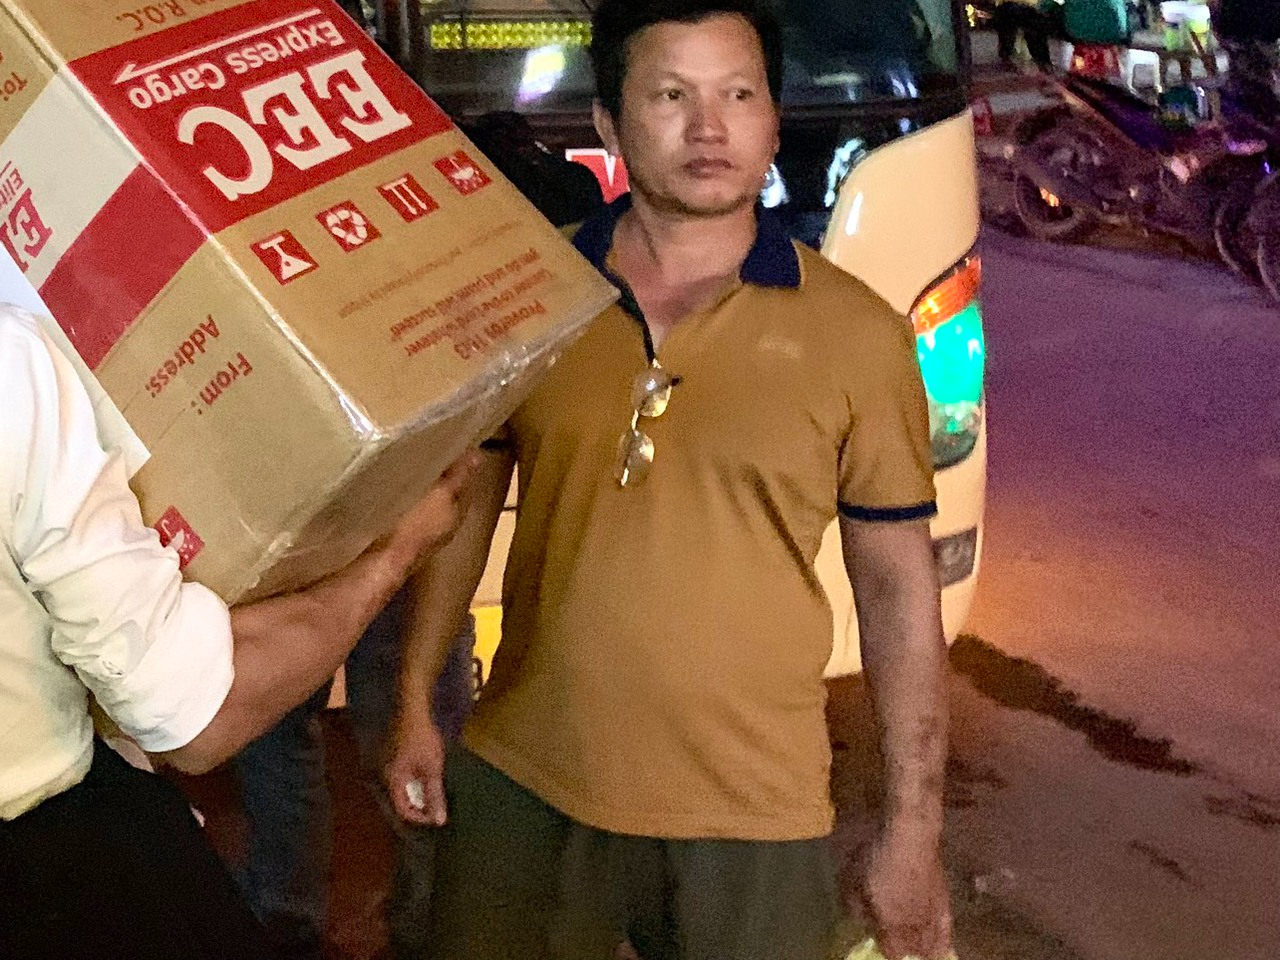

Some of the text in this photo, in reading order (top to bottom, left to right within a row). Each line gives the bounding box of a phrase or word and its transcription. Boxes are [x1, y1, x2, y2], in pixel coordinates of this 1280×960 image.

[116, 0, 186, 32] R.O.C.
[0, 71, 28, 102] To:
[128, 21, 345, 110] Express Cargo
[178, 49, 413, 201] EEC
[145, 314, 220, 398] Address:
